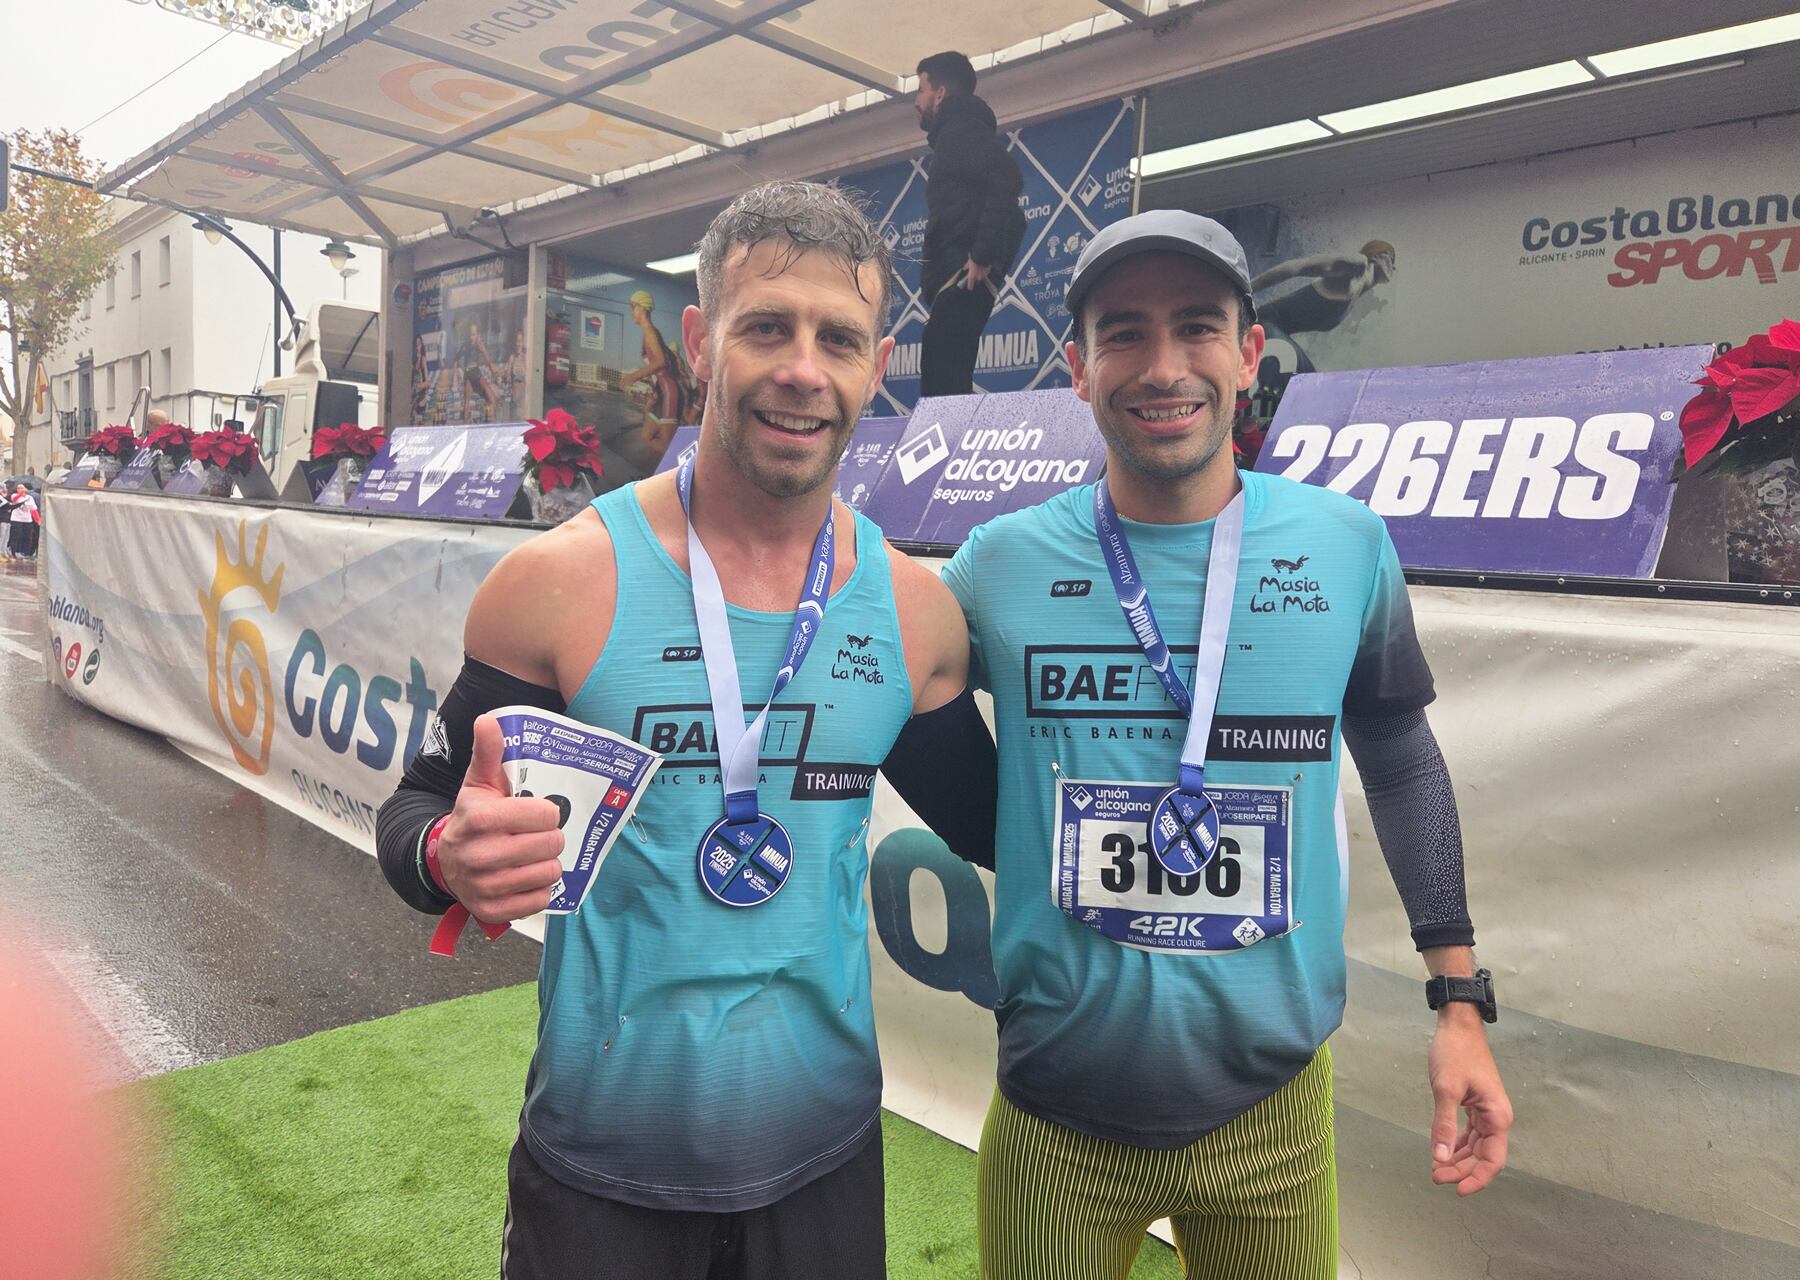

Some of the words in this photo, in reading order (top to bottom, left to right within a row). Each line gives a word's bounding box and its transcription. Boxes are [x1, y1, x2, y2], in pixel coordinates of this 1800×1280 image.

[1104, 181, 1131, 199] alco
[1522, 194, 1800, 252] CostaBlan
[1519, 252, 1567, 266] ALICANTE
[1575, 247, 1606, 260] SPAIN
[1034, 288, 1060, 301] TROYA
[961, 420, 1043, 451] unión
[944, 451, 1090, 492] alcoyana
[1272, 411, 1654, 520] 226ERS
[932, 486, 994, 505] seguros
[1109, 532, 1135, 585] Alzamora
[1070, 583, 1087, 593] SP
[1259, 576, 1320, 593] Masia
[1250, 594, 1276, 613] La
[1284, 595, 1330, 613] Mota
[1129, 604, 1158, 650] MMUA
[683, 650, 697, 658] SP
[838, 649, 878, 667] Masia
[831, 663, 849, 680] La
[853, 667, 884, 685] Mota
[284, 628, 437, 776] Cost
[1030, 725, 1073, 739] ERIC
[1091, 726, 1172, 740] BAENA
[1219, 728, 1327, 751] TRAINING
[551, 739, 580, 755] Visauto
[291, 768, 380, 835] ALICANT
[611, 795, 620, 806] A
[1095, 787, 1129, 800] unión
[1094, 800, 1151, 815] alcoyana
[596, 812, 613, 828] 1/2
[1160, 811, 1180, 837] 2025
[578, 825, 604, 872] MARATÓN
[1062, 823, 1076, 867] MMUA2025
[709, 845, 737, 870] 2025
[759, 844, 789, 873] MMUA
[1269, 856, 1282, 873] 1/2
[1060, 869, 1073, 909] MARATÓN
[1269, 873, 1282, 916] MARATÓN
[1129, 915, 1205, 938] 42K
[1127, 933, 1157, 946] RUNNING
[1157, 937, 1176, 947] RACE
[1176, 938, 1207, 948] CULTURE
